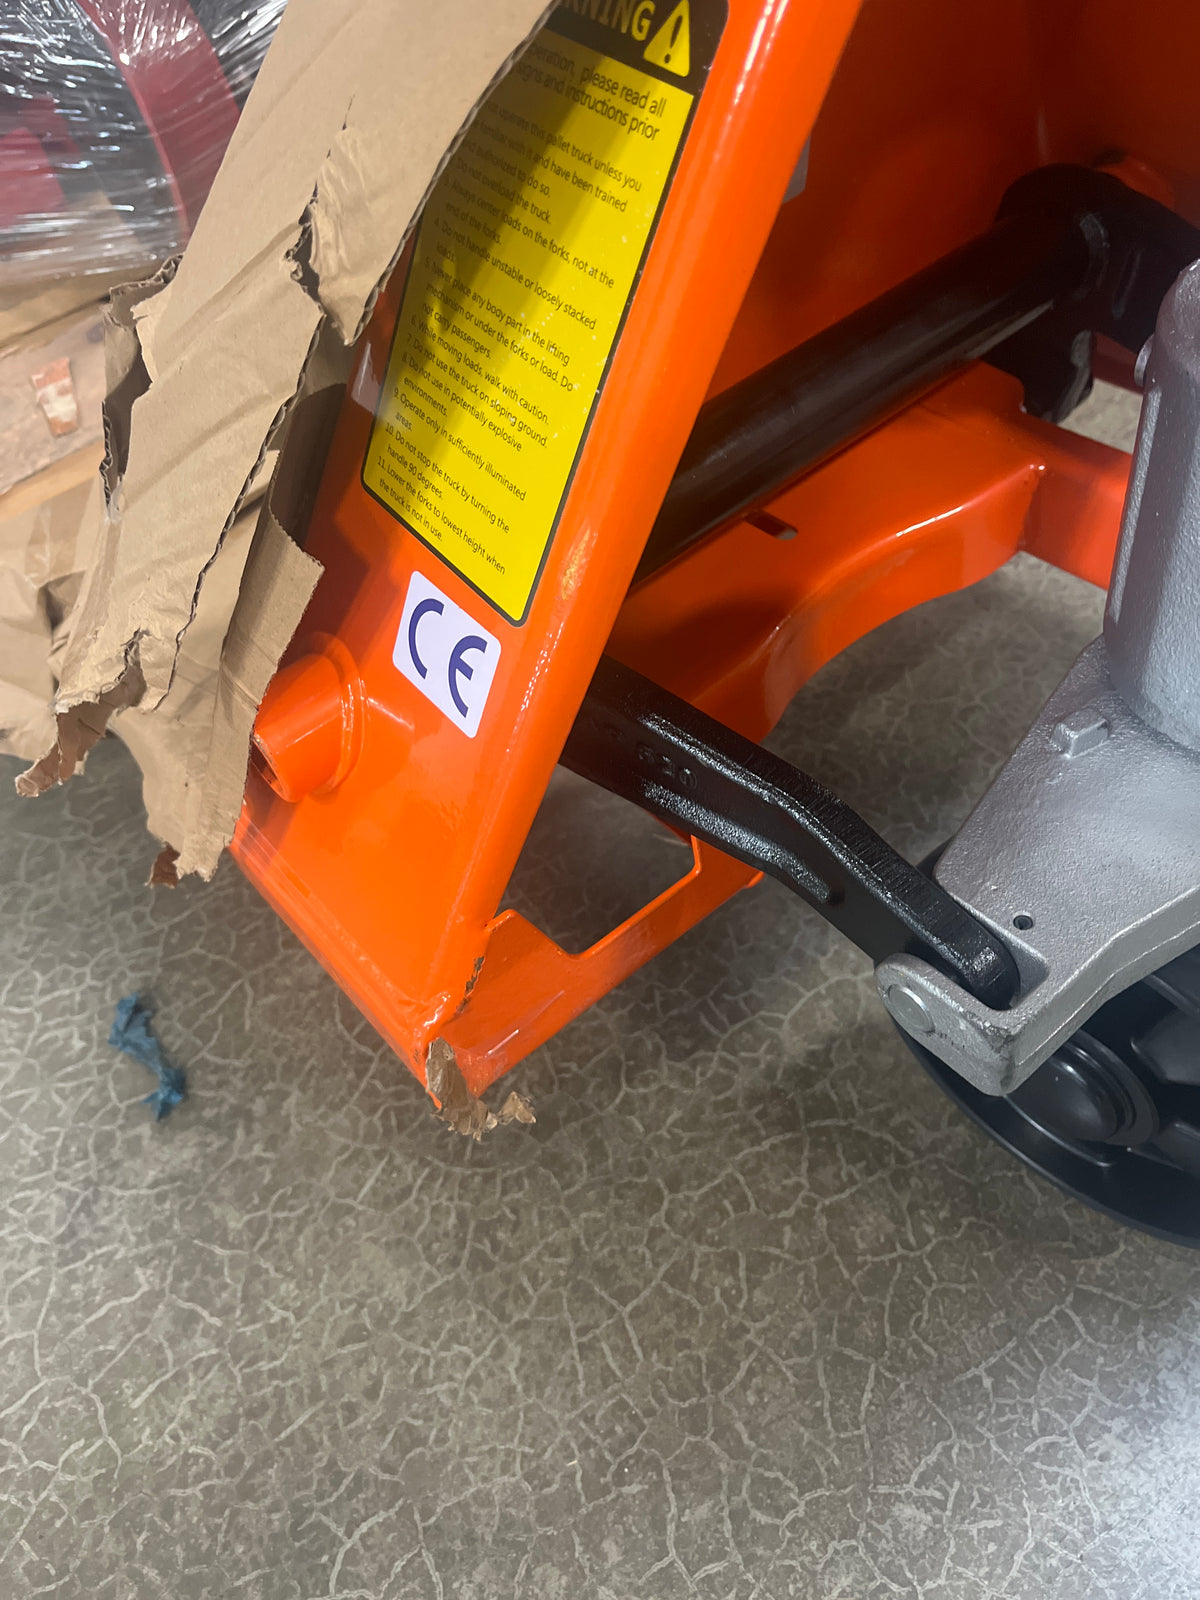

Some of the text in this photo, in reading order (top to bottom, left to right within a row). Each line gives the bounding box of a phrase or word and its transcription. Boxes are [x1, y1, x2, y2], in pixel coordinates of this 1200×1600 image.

[543, 73, 564, 94] and
[565, 82, 629, 127] instructions
[628, 117, 659, 141] prior
[580, 66, 619, 95] please
[620, 86, 650, 109] read
[649, 97, 667, 118] all
[517, 168, 526, 183] to
[527, 175, 539, 189] do
[533, 153, 550, 169] and
[550, 160, 571, 181] have
[571, 171, 593, 194] been
[594, 185, 628, 212] trained
[545, 131, 570, 153] pallet
[571, 145, 594, 166] truck
[594, 159, 623, 182] unless
[622, 175, 642, 192] you
[515, 193, 529, 210] the
[441, 221, 453, 236] Do
[453, 231, 466, 246] not
[466, 236, 491, 262] handle
[491, 256, 524, 283] unstable
[524, 279, 534, 290] or
[534, 281, 563, 311] loosely
[564, 303, 597, 330] stacked
[500, 208, 522, 232] loads
[522, 226, 534, 239] on
[534, 231, 548, 248] the
[549, 239, 570, 263] forks,
[573, 257, 588, 272] not
[588, 267, 598, 279] at
[599, 271, 614, 288] the
[422, 303, 491, 359] not carry passengers.
[426, 283, 573, 391] mechanism or under the forks or load. Do
[452, 278, 472, 298] place
[472, 292, 486, 308] any
[486, 299, 506, 321] body
[505, 315, 522, 330] part
[523, 324, 531, 337] in
[531, 331, 546, 347] the
[546, 339, 570, 367] lifting
[404, 377, 448, 417] environments.
[408, 356, 419, 372] Do
[419, 368, 431, 381] not
[431, 377, 443, 391] use
[443, 383, 451, 396] in
[450, 391, 488, 427] potentially
[488, 420, 522, 452] explosive
[413, 339, 424, 353] Do
[424, 349, 435, 363] not
[436, 358, 448, 372] use
[449, 366, 460, 381] the
[460, 376, 479, 396] truck
[479, 391, 489, 403] on
[489, 398, 517, 427] sloping
[517, 421, 547, 449] ground.
[419, 321, 437, 341] While
[437, 337, 463, 363] moving
[463, 353, 483, 376] loads,
[484, 372, 501, 389] walk
[502, 384, 518, 402] with
[519, 397, 549, 425] caution.
[395, 411, 413, 432] areas.
[400, 393, 425, 420] Operate
[425, 417, 440, 434] only
[440, 426, 448, 439] in
[448, 433, 485, 470] sufficiently
[484, 463, 527, 501] illuminated
[387, 443, 443, 500] handle 90 degrees.
[395, 430, 405, 445] Do
[405, 440, 417, 455] not
[417, 450, 431, 468] stop
[431, 461, 443, 478] the
[443, 472, 461, 493] truck
[460, 485, 471, 502] by
[470, 495, 497, 525] turning
[496, 517, 510, 534] the
[379, 477, 443, 542] the truck is not in use.
[387, 463, 405, 486] Lower
[405, 480, 417, 497] the
[416, 490, 433, 511] forks
[433, 505, 441, 518] to
[440, 511, 463, 538] lowest
[462, 531, 486, 558] height
[486, 553, 506, 575] when
[408, 598, 488, 718] CE
